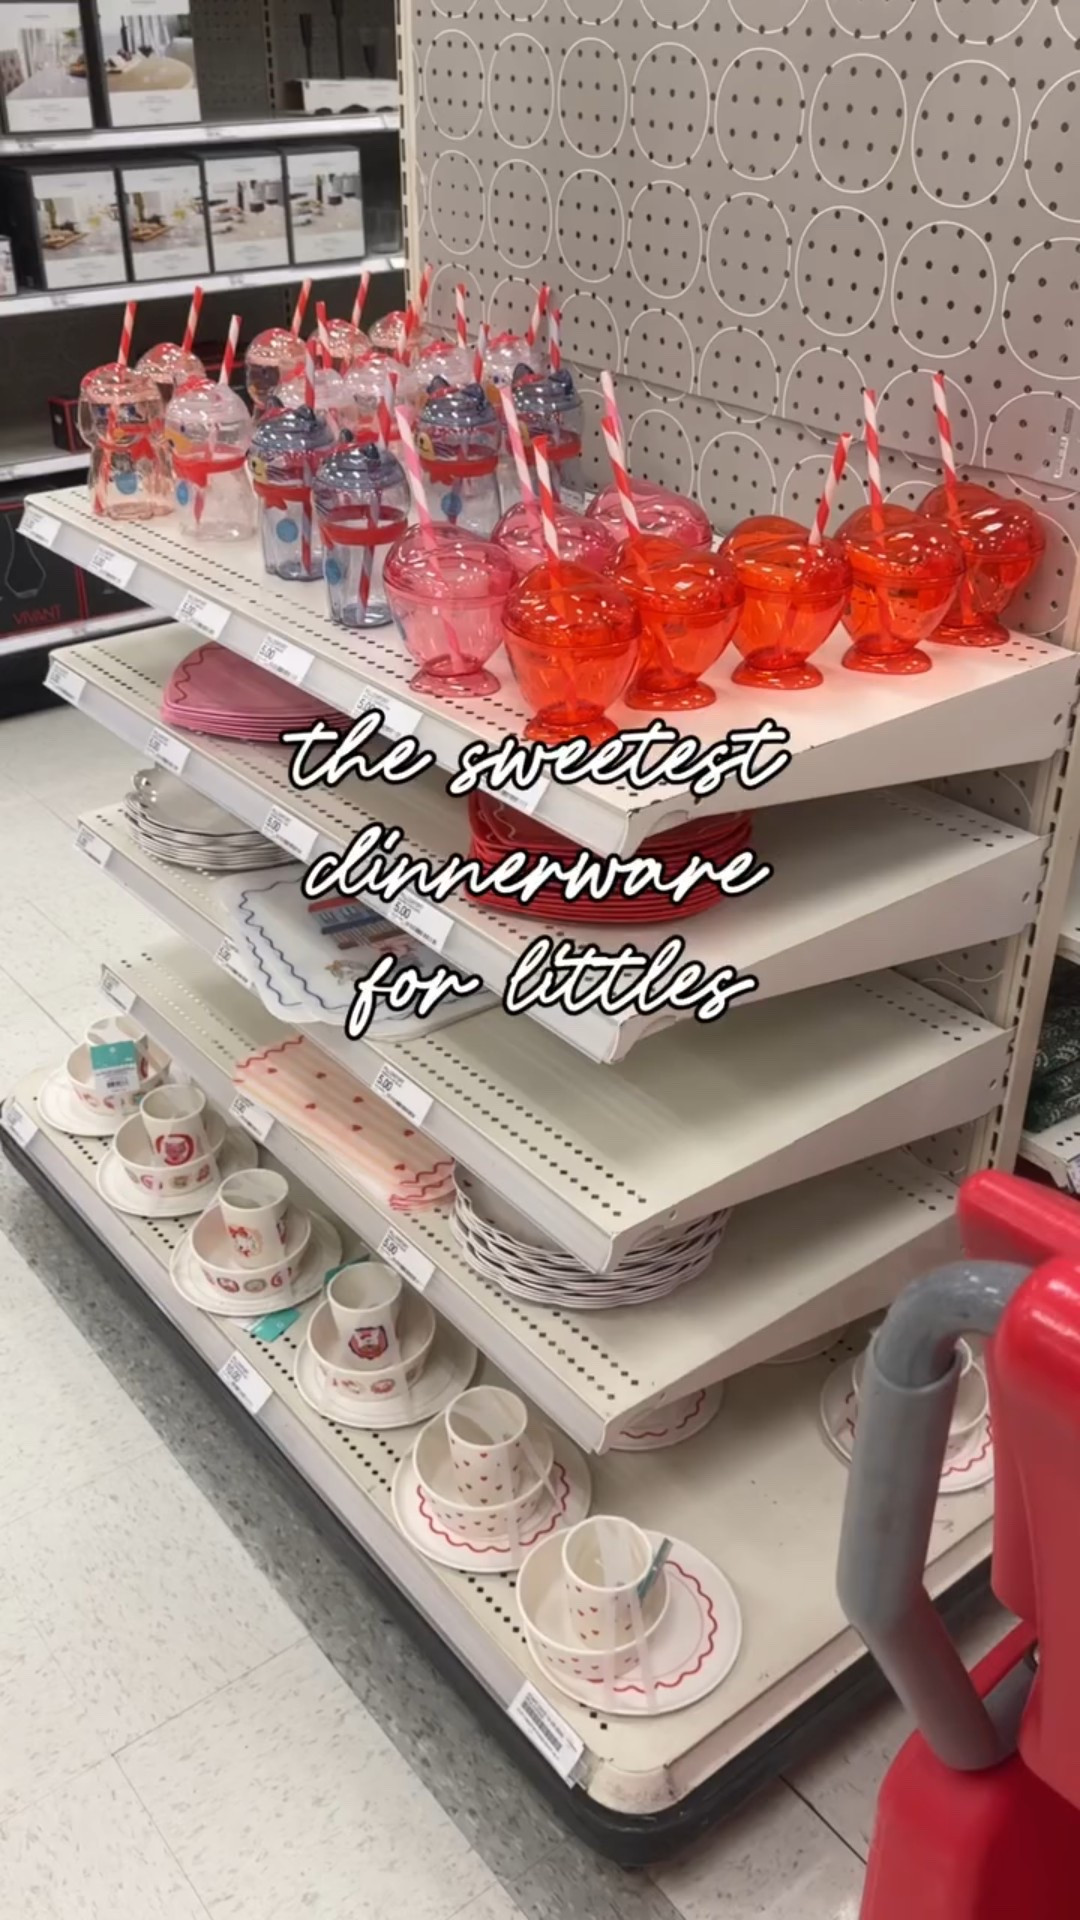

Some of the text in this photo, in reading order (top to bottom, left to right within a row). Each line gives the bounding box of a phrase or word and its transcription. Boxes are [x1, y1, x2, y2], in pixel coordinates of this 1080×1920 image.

[259, 644, 276, 660] 5.00
[266, 816, 281, 832] 5.00
[393, 901, 411, 919] 5.00
[376, 1074, 393, 1091] 5.00
[383, 1238, 398, 1255] 5.00
